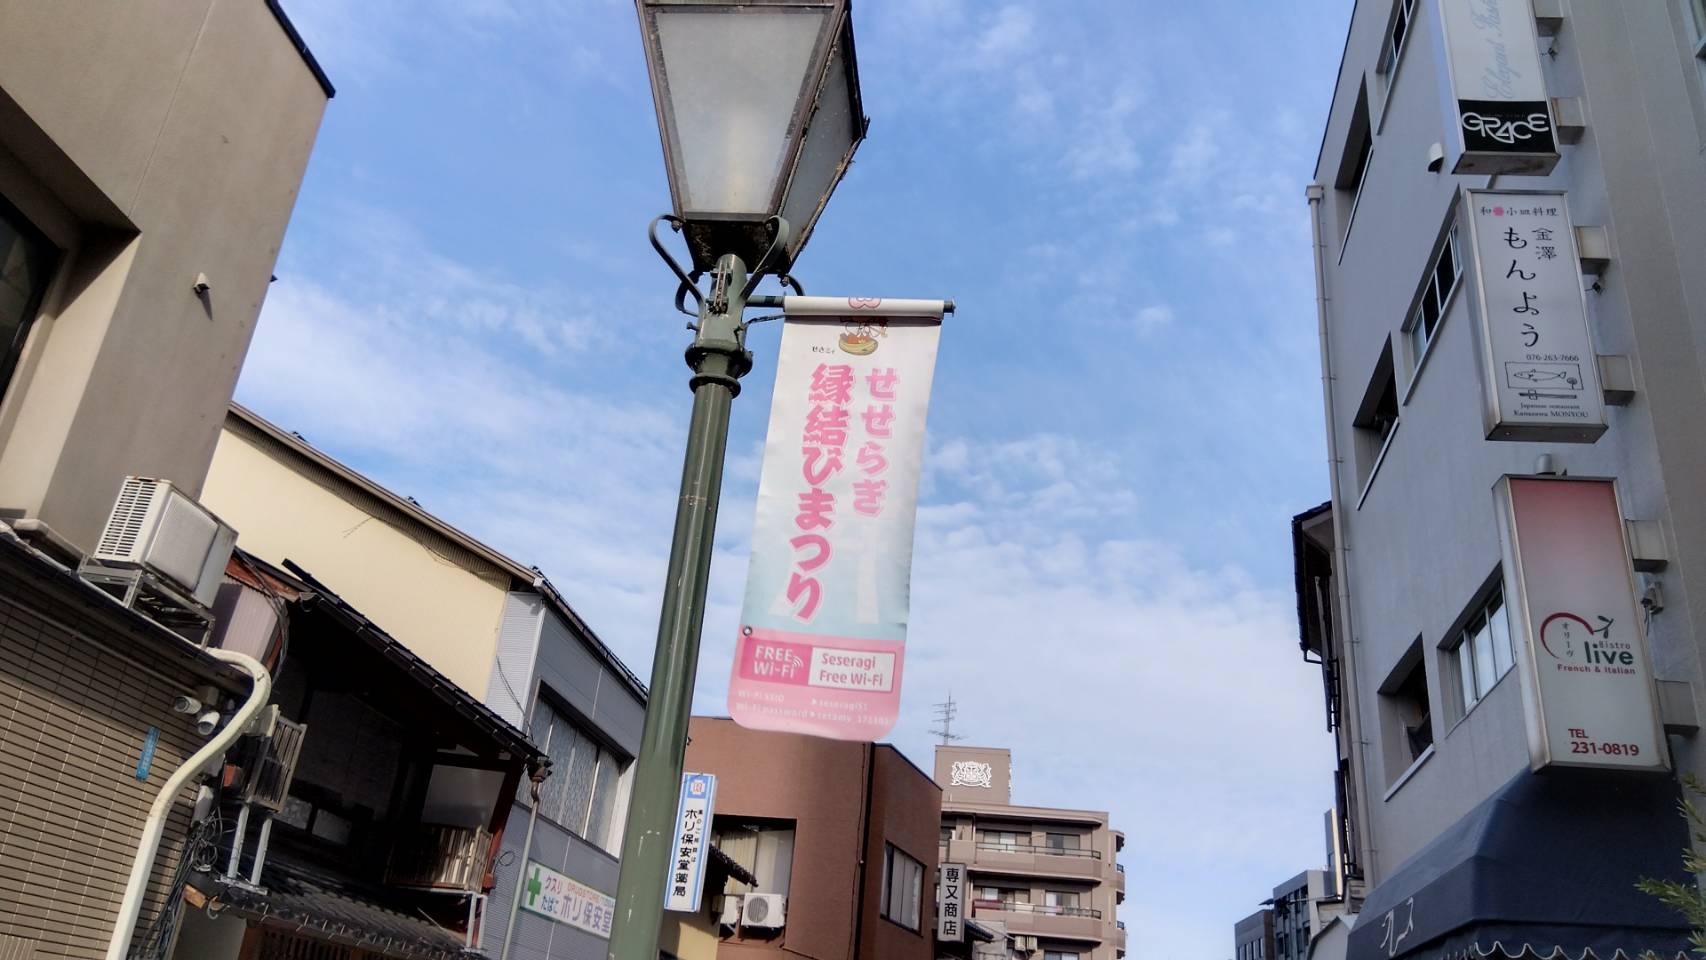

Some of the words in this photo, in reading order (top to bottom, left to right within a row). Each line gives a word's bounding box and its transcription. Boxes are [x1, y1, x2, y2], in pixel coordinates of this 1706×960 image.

[1461, 112, 1549, 144] GRACE
[1503, 226, 1541, 348] もんよう
[851, 367, 900, 517] せせらぎ
[786, 363, 856, 622] 縁結びまつり
[755, 645, 793, 662] FREE
[821, 653, 876, 669] Seseragi
[753, 661, 795, 679] Wi-Fi
[1557, 664, 1591, 673] French
[1604, 666, 1636, 675] Italian
[819, 671, 848, 685] Free
[850, 673, 884, 687] Wi-Fi
[1568, 728, 1589, 739] TEL
[1571, 741, 1640, 756] 231-0819
[673, 809, 698, 897] ホリ保安堂薬局
